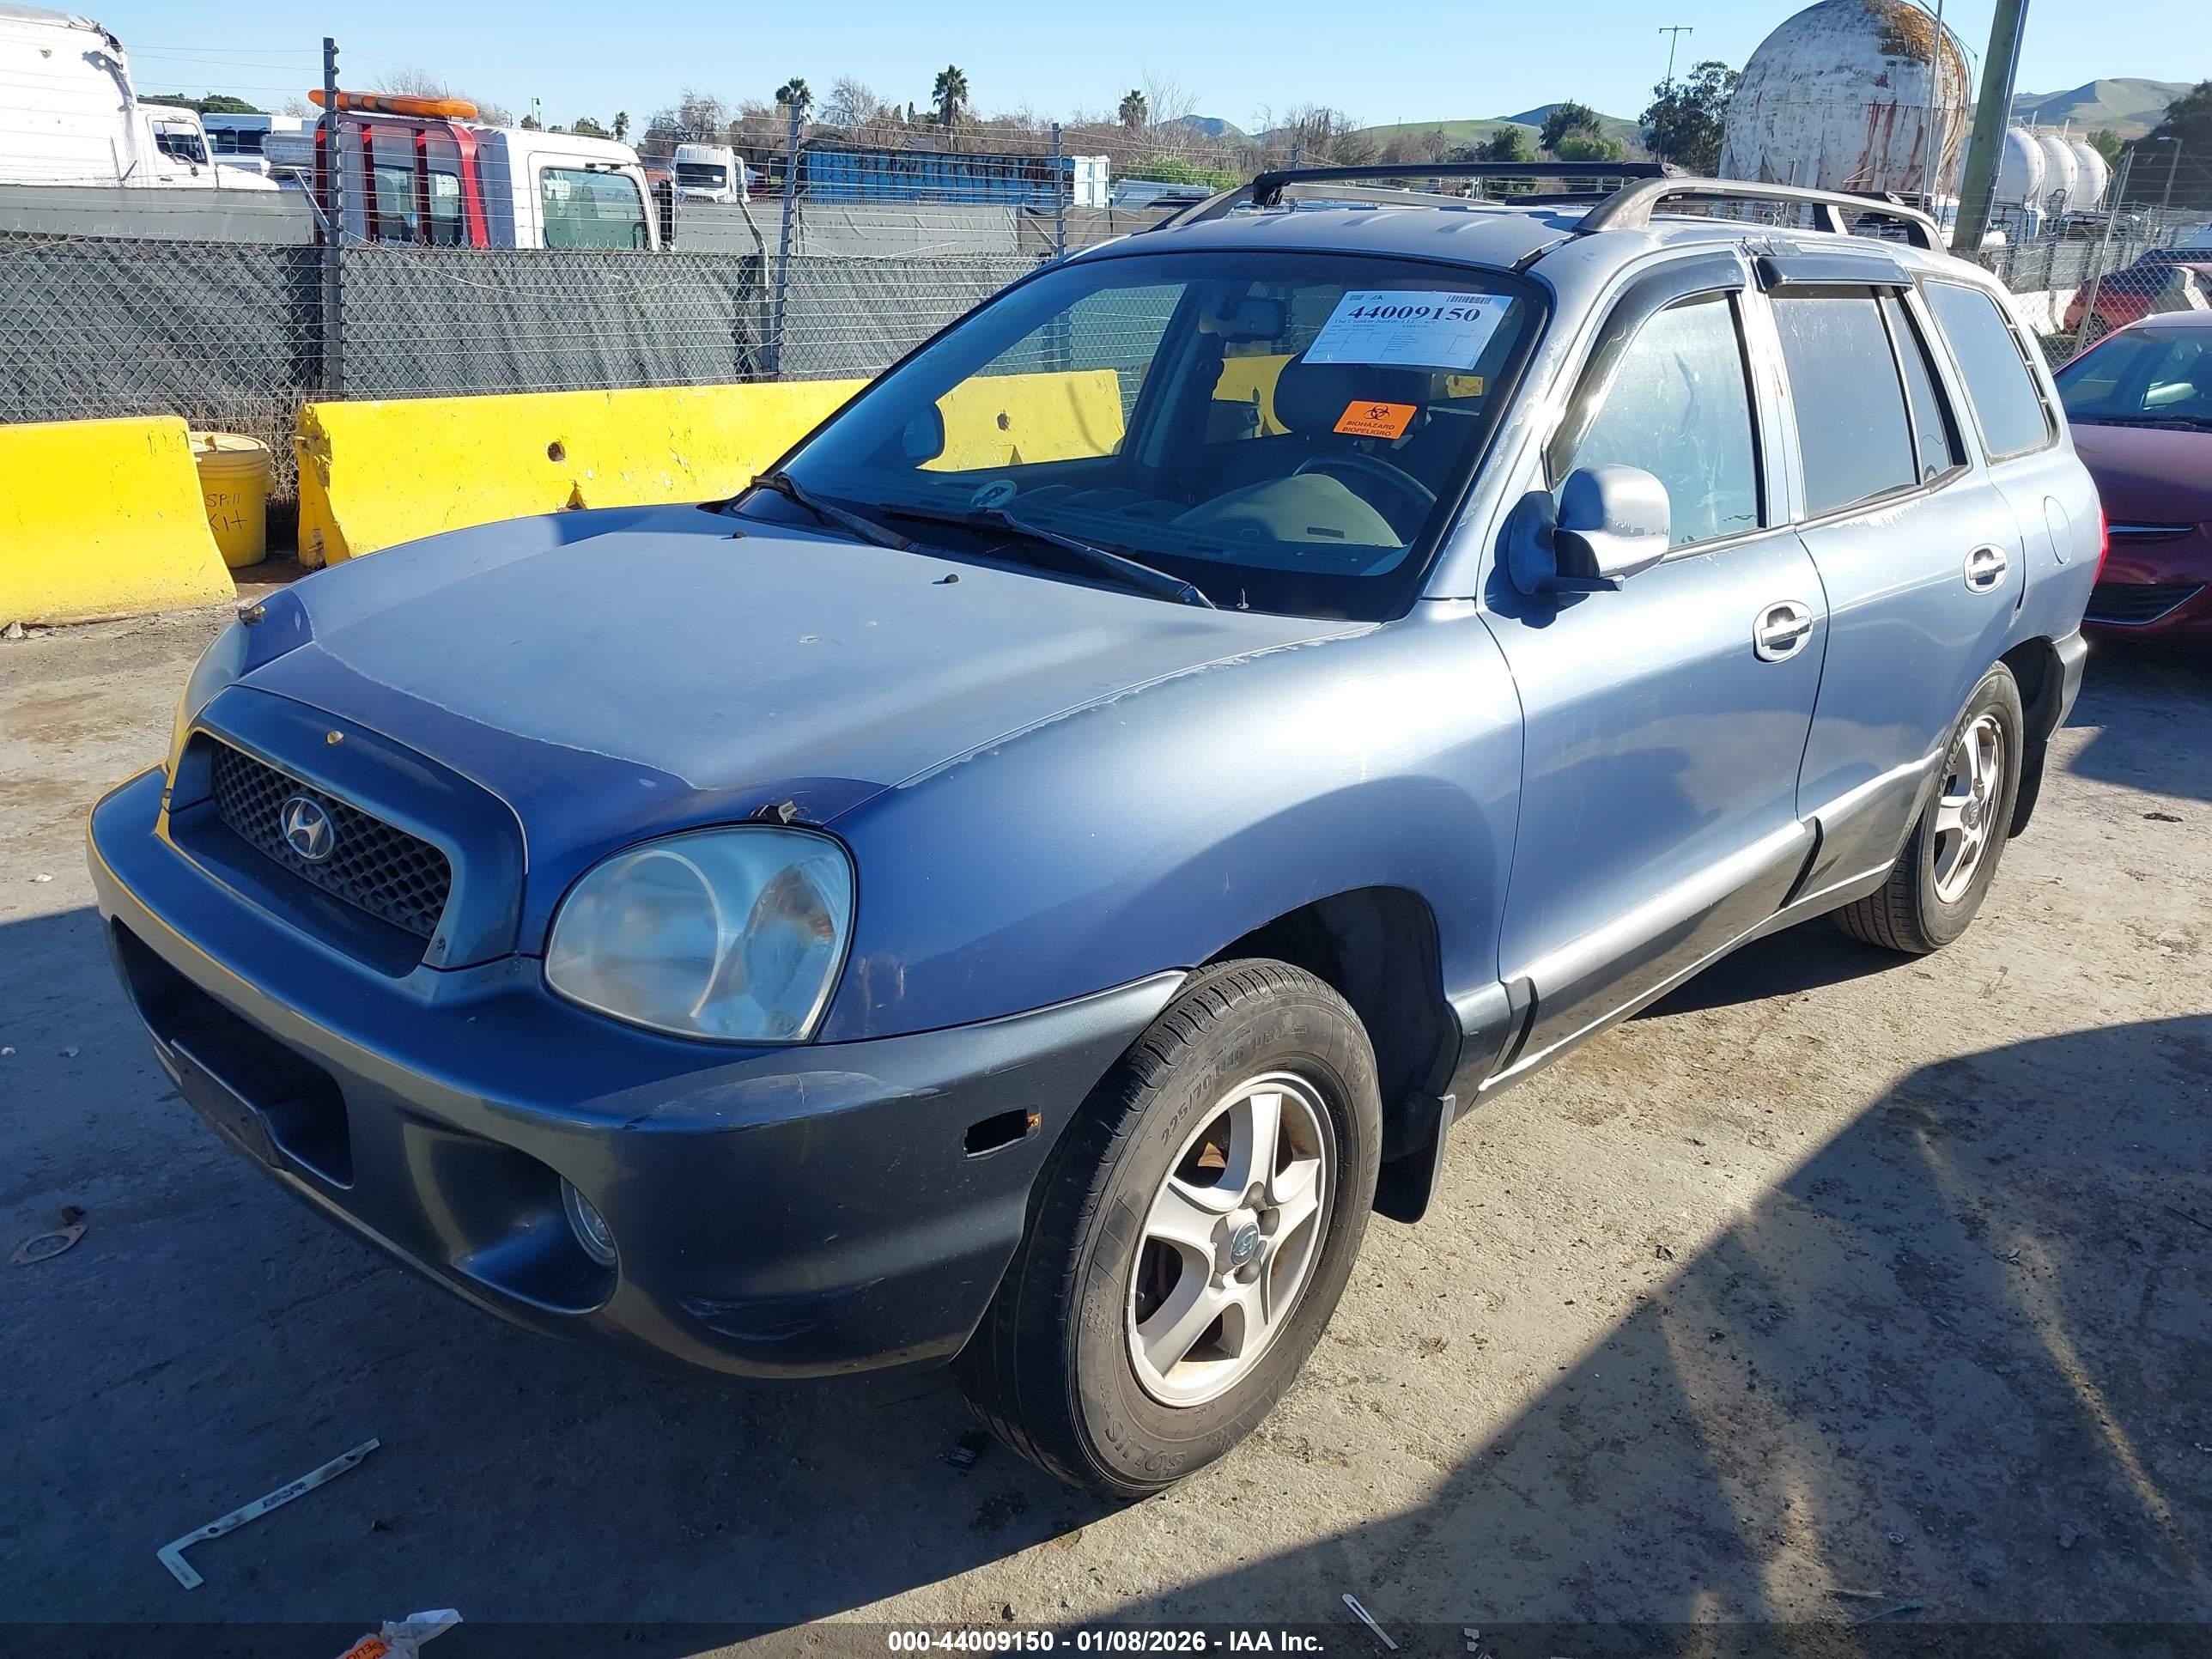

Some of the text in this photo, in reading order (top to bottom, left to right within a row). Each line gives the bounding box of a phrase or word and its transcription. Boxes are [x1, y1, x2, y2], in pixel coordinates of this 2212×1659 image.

[1347, 305, 1481, 322] 44009150
[1346, 420, 1395, 430] BIOHAZARD
[1341, 427, 1392, 437] BIOPELIGRO
